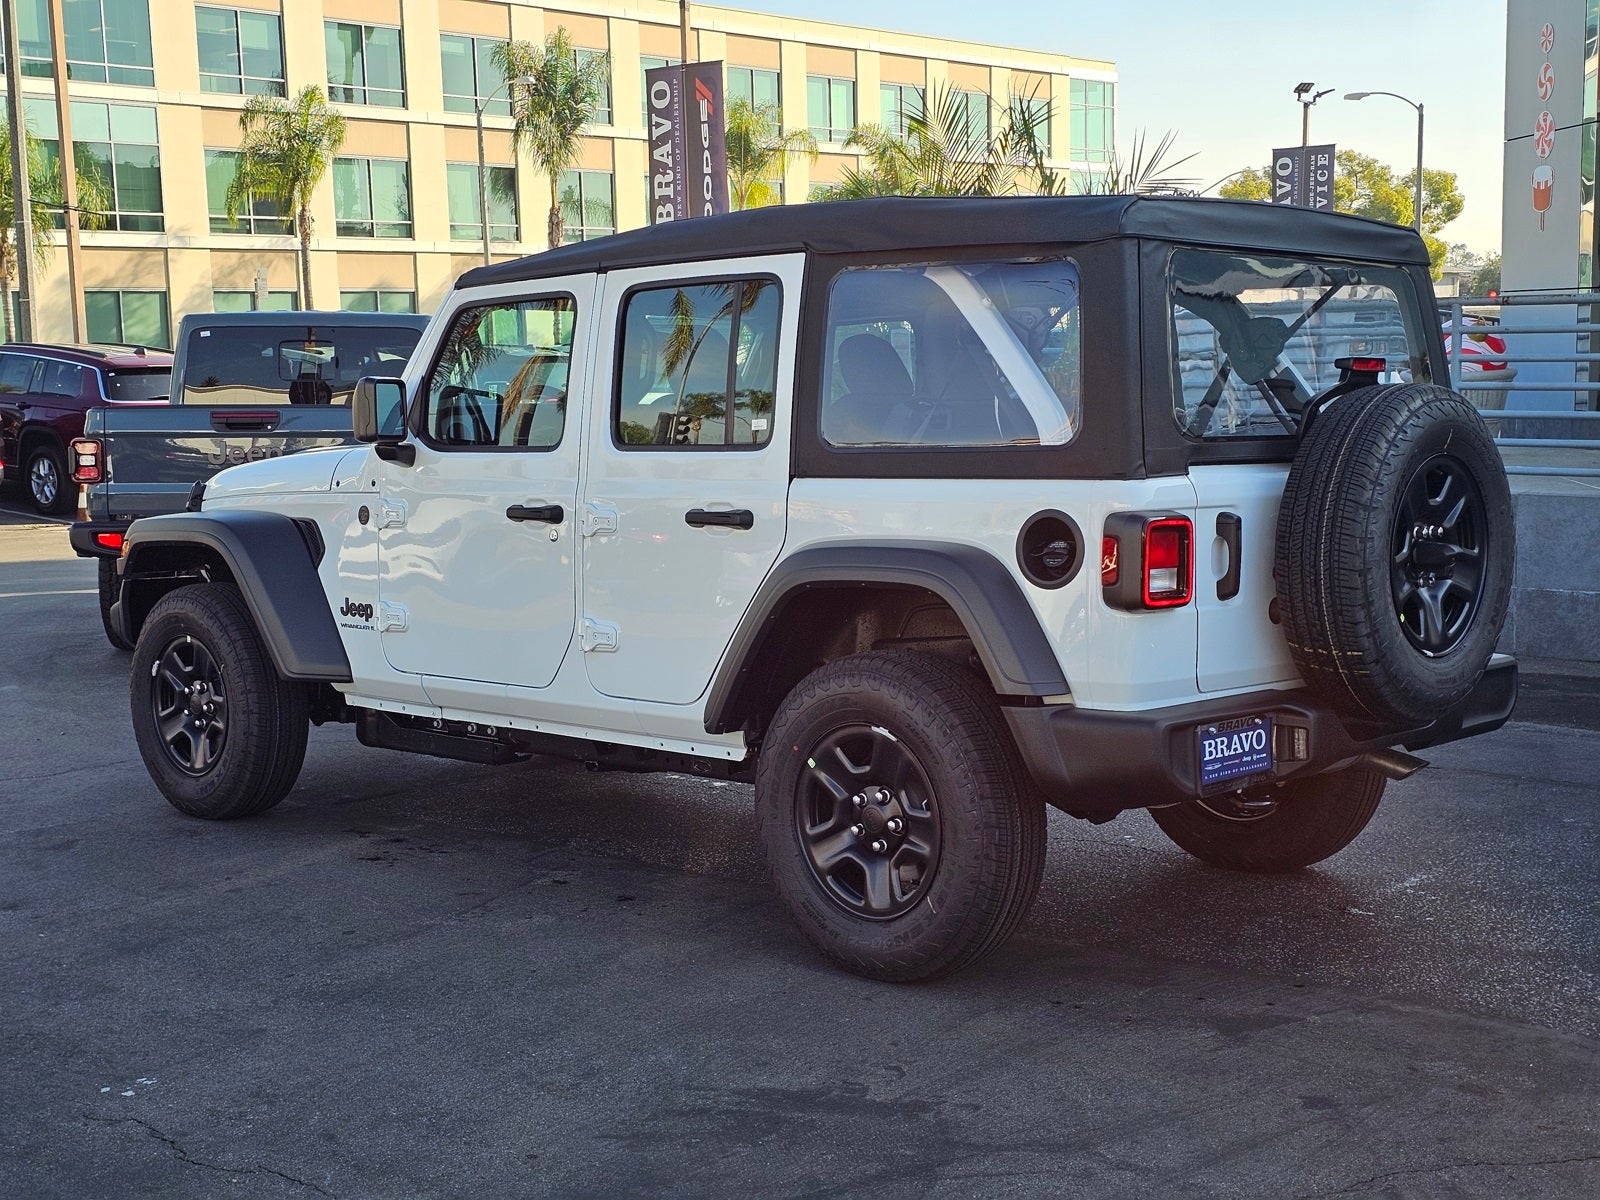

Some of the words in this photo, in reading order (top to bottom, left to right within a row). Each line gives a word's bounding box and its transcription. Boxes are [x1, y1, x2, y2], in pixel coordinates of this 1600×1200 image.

[650, 80, 675, 225] BRAVO
[675, 148, 681, 161] OF
[340, 597, 374, 622] Jeep
[1218, 716, 1261, 733] BRAVO
[1203, 729, 1266, 761] BRAVO
